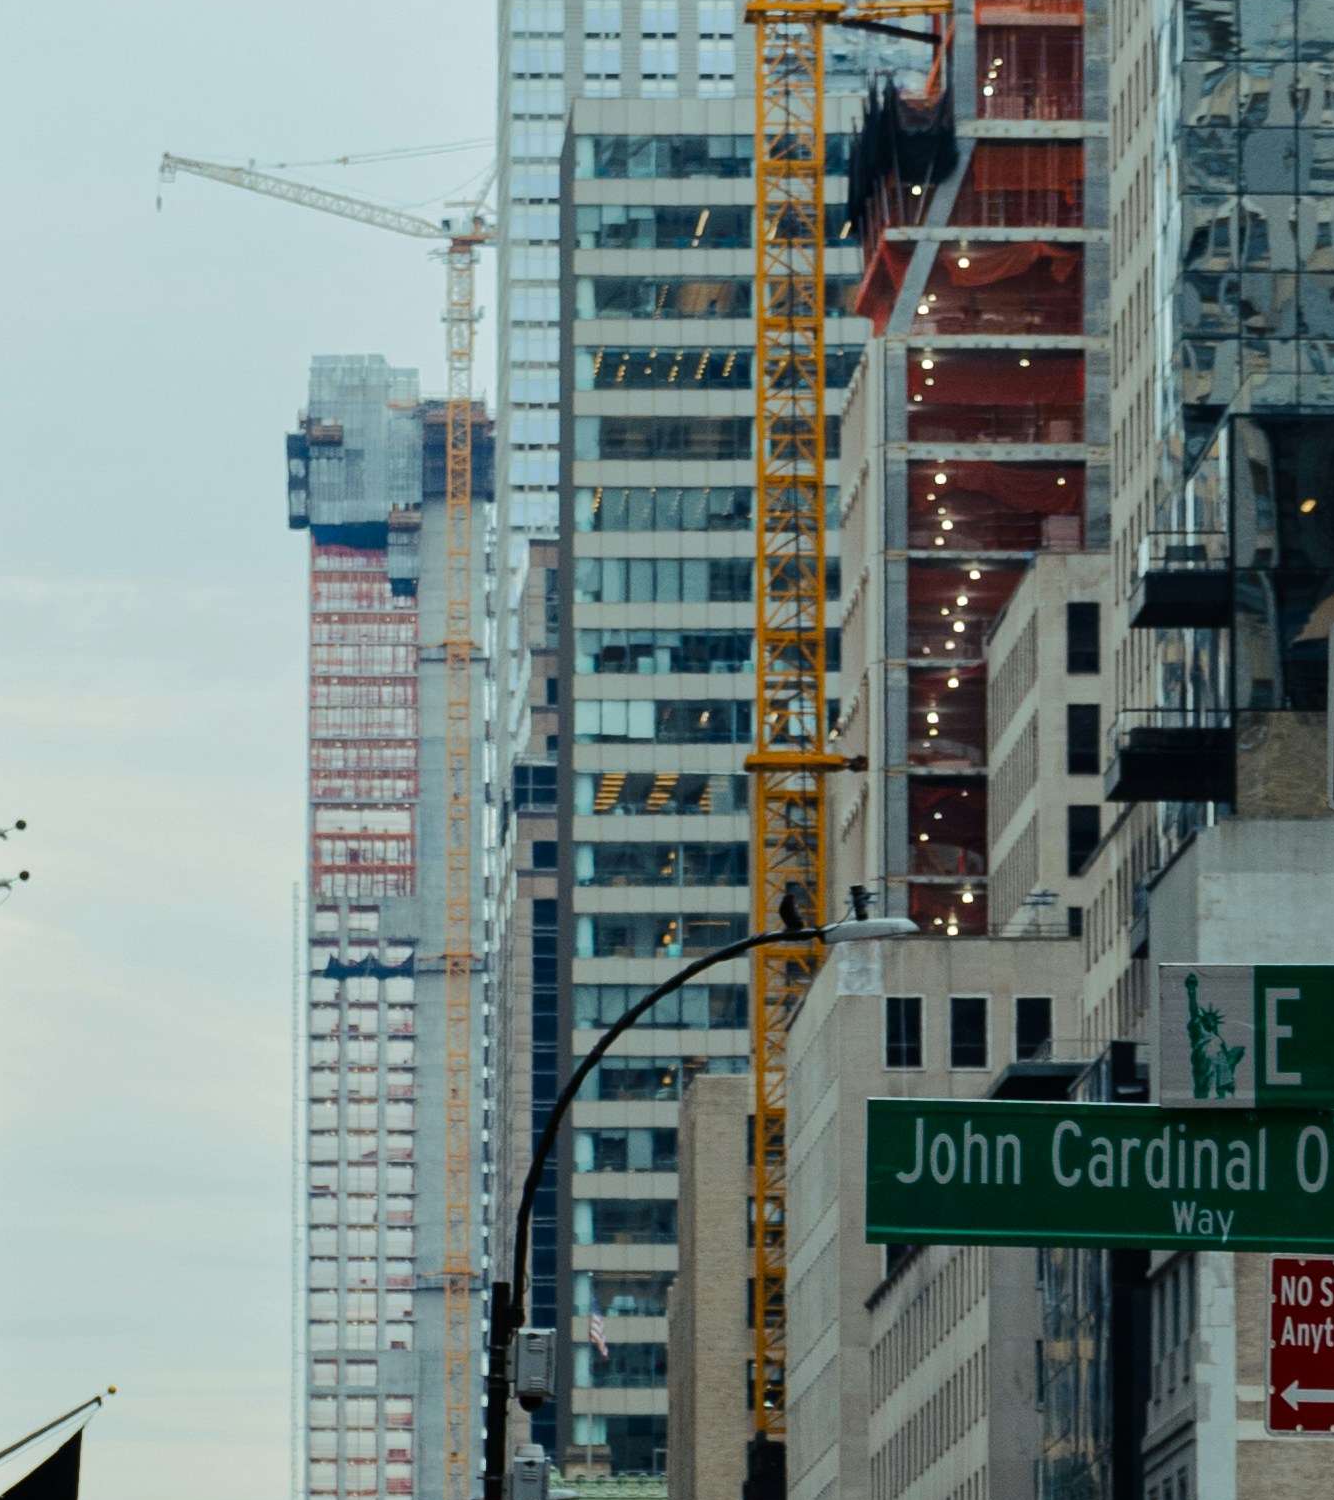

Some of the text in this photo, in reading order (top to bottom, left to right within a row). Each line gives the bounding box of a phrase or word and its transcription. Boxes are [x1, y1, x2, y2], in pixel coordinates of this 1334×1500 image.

[1266, 987, 1302, 1086] E
[896, 1118, 1022, 1186] John
[1051, 1120, 1266, 1192] Cardinal
[1173, 1201, 1235, 1243] Way
[1280, 1275, 1314, 1308] NO
